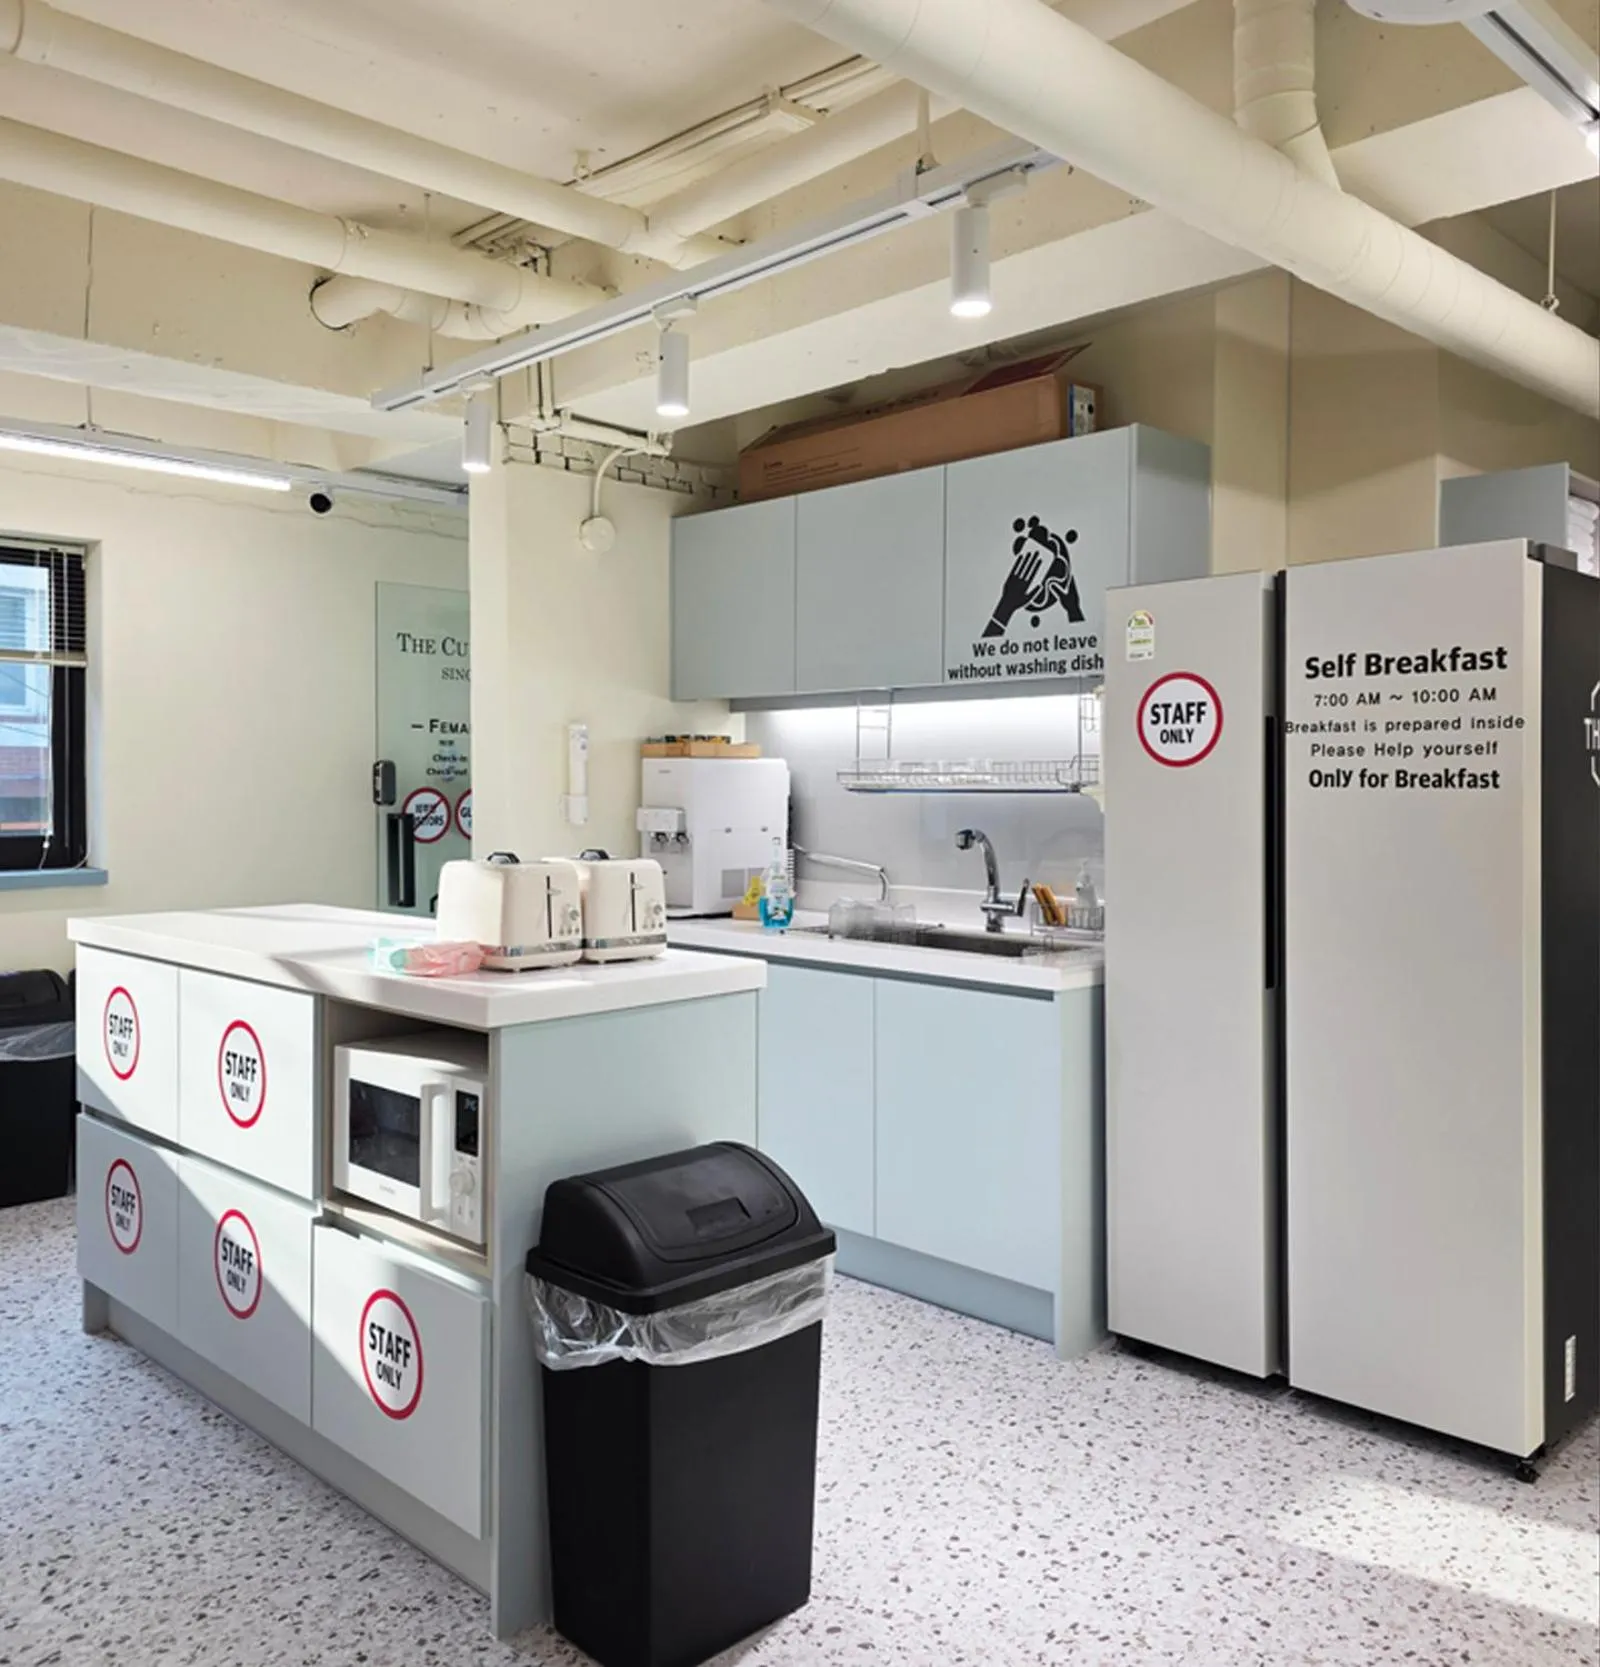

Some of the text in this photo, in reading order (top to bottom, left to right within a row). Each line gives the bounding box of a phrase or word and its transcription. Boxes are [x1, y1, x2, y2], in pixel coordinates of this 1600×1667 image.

[396, 632, 436, 655] THE
[972, 634, 1098, 657] We do not leave
[948, 662, 1002, 680] without
[1006, 658, 1067, 675] washing
[1304, 646, 1508, 679] Self Breakfast
[1313, 693, 1349, 707] 7:00
[1356, 692, 1381, 705] AM
[1412, 689, 1460, 704] 10:00
[1469, 687, 1497, 701] AM
[1150, 701, 1208, 725] STAFF
[1285, 719, 1357, 733] Breakfast
[1364, 719, 1377, 731] is
[1385, 716, 1462, 733] prepared
[1160, 728, 1195, 745] ONLY
[1311, 740, 1499, 759] Please Help yourself
[1309, 768, 1500, 789] Only for Breakfast
[109, 1013, 134, 1040] STAFF
[225, 1050, 258, 1084] STAFF
[231, 1081, 251, 1103] ONLY
[111, 1184, 136, 1217] STAFF
[222, 1236, 254, 1275] STAFF
[227, 1270, 247, 1294] ONLY
[368, 1323, 412, 1369] STAFF
[377, 1358, 403, 1390] ONLY
